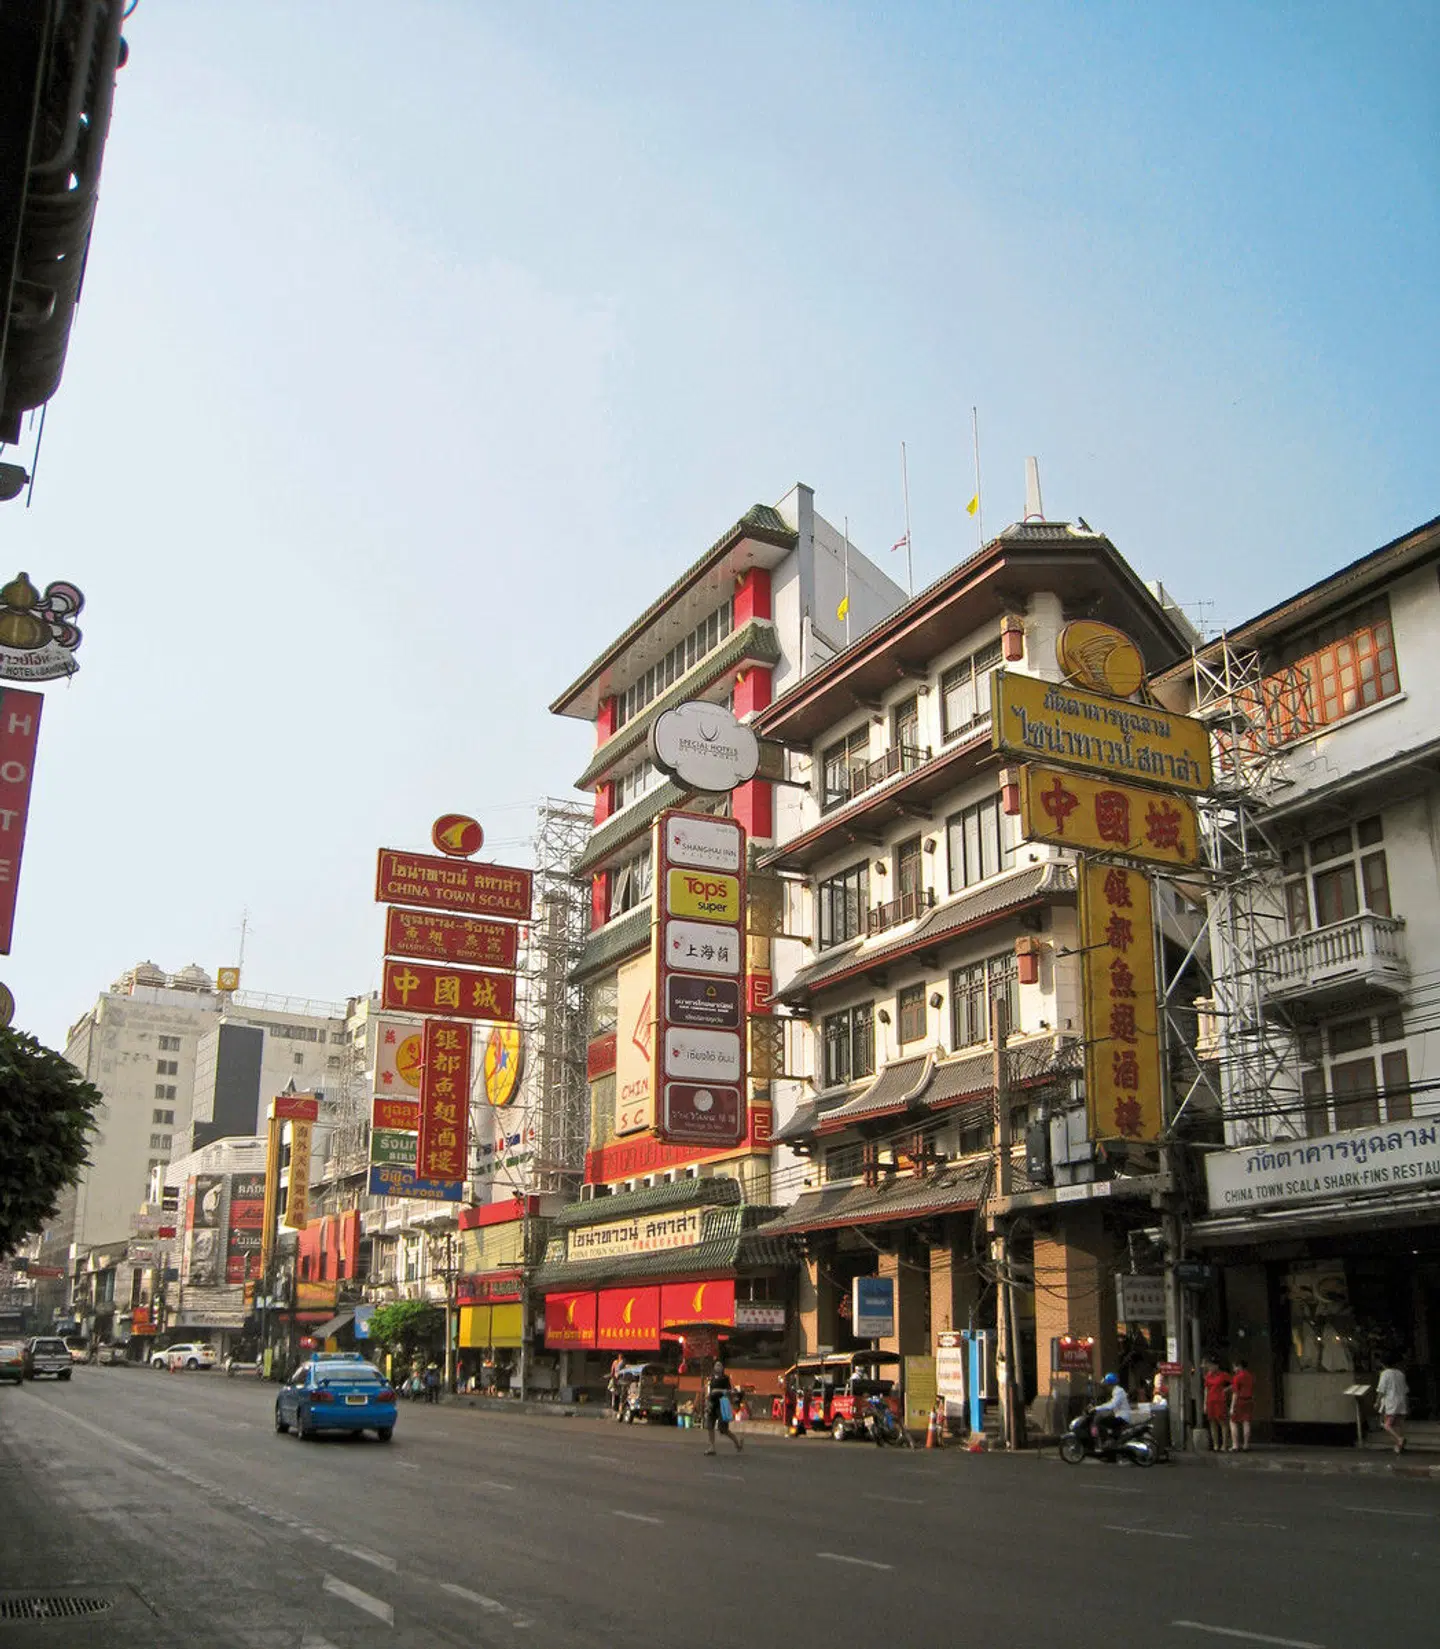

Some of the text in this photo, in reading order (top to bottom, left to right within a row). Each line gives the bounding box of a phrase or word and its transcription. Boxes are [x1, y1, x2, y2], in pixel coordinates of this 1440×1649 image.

[1137, 746, 1201, 784] สกาล่า
[1041, 775, 1186, 858] 中國城
[682, 843, 721, 854] SHANGHAI
[387, 882, 522, 910] CHINA TOWN SCALA
[683, 876, 727, 901] Tops
[698, 901, 728, 913] super
[393, 968, 501, 1015] 中國城
[1225, 1189, 1253, 1204] CHINA
[1256, 1184, 1284, 1199] TOWN
[1287, 1179, 1321, 1195] SCALA
